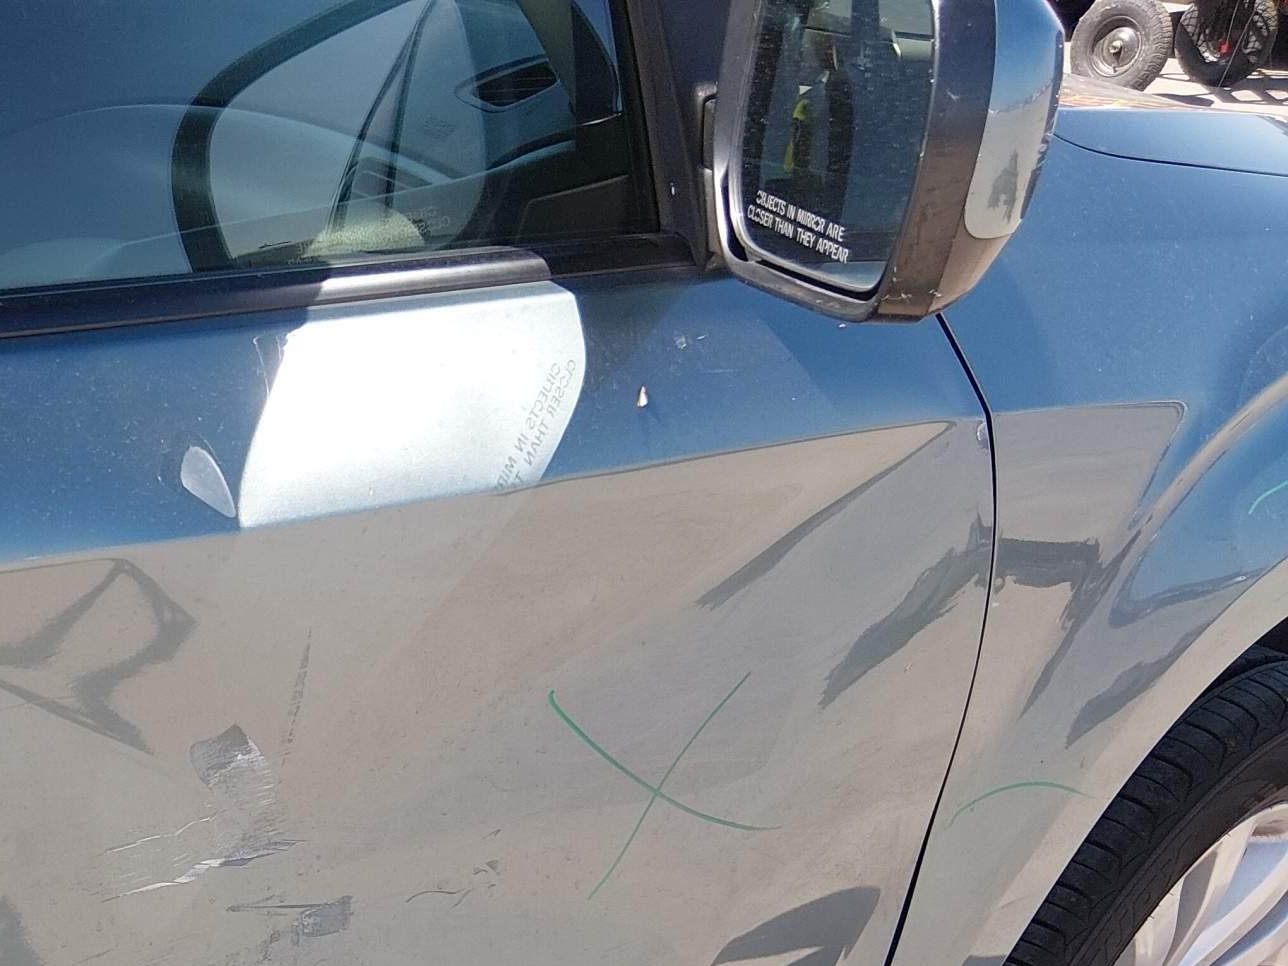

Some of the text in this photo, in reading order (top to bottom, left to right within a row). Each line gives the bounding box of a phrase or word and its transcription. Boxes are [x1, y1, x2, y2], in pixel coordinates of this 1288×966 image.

[747, 205, 849, 264] CLOSER THAN THEY APPEAR
[756, 190, 845, 242] OBJECTS IN MIRROR ARE
